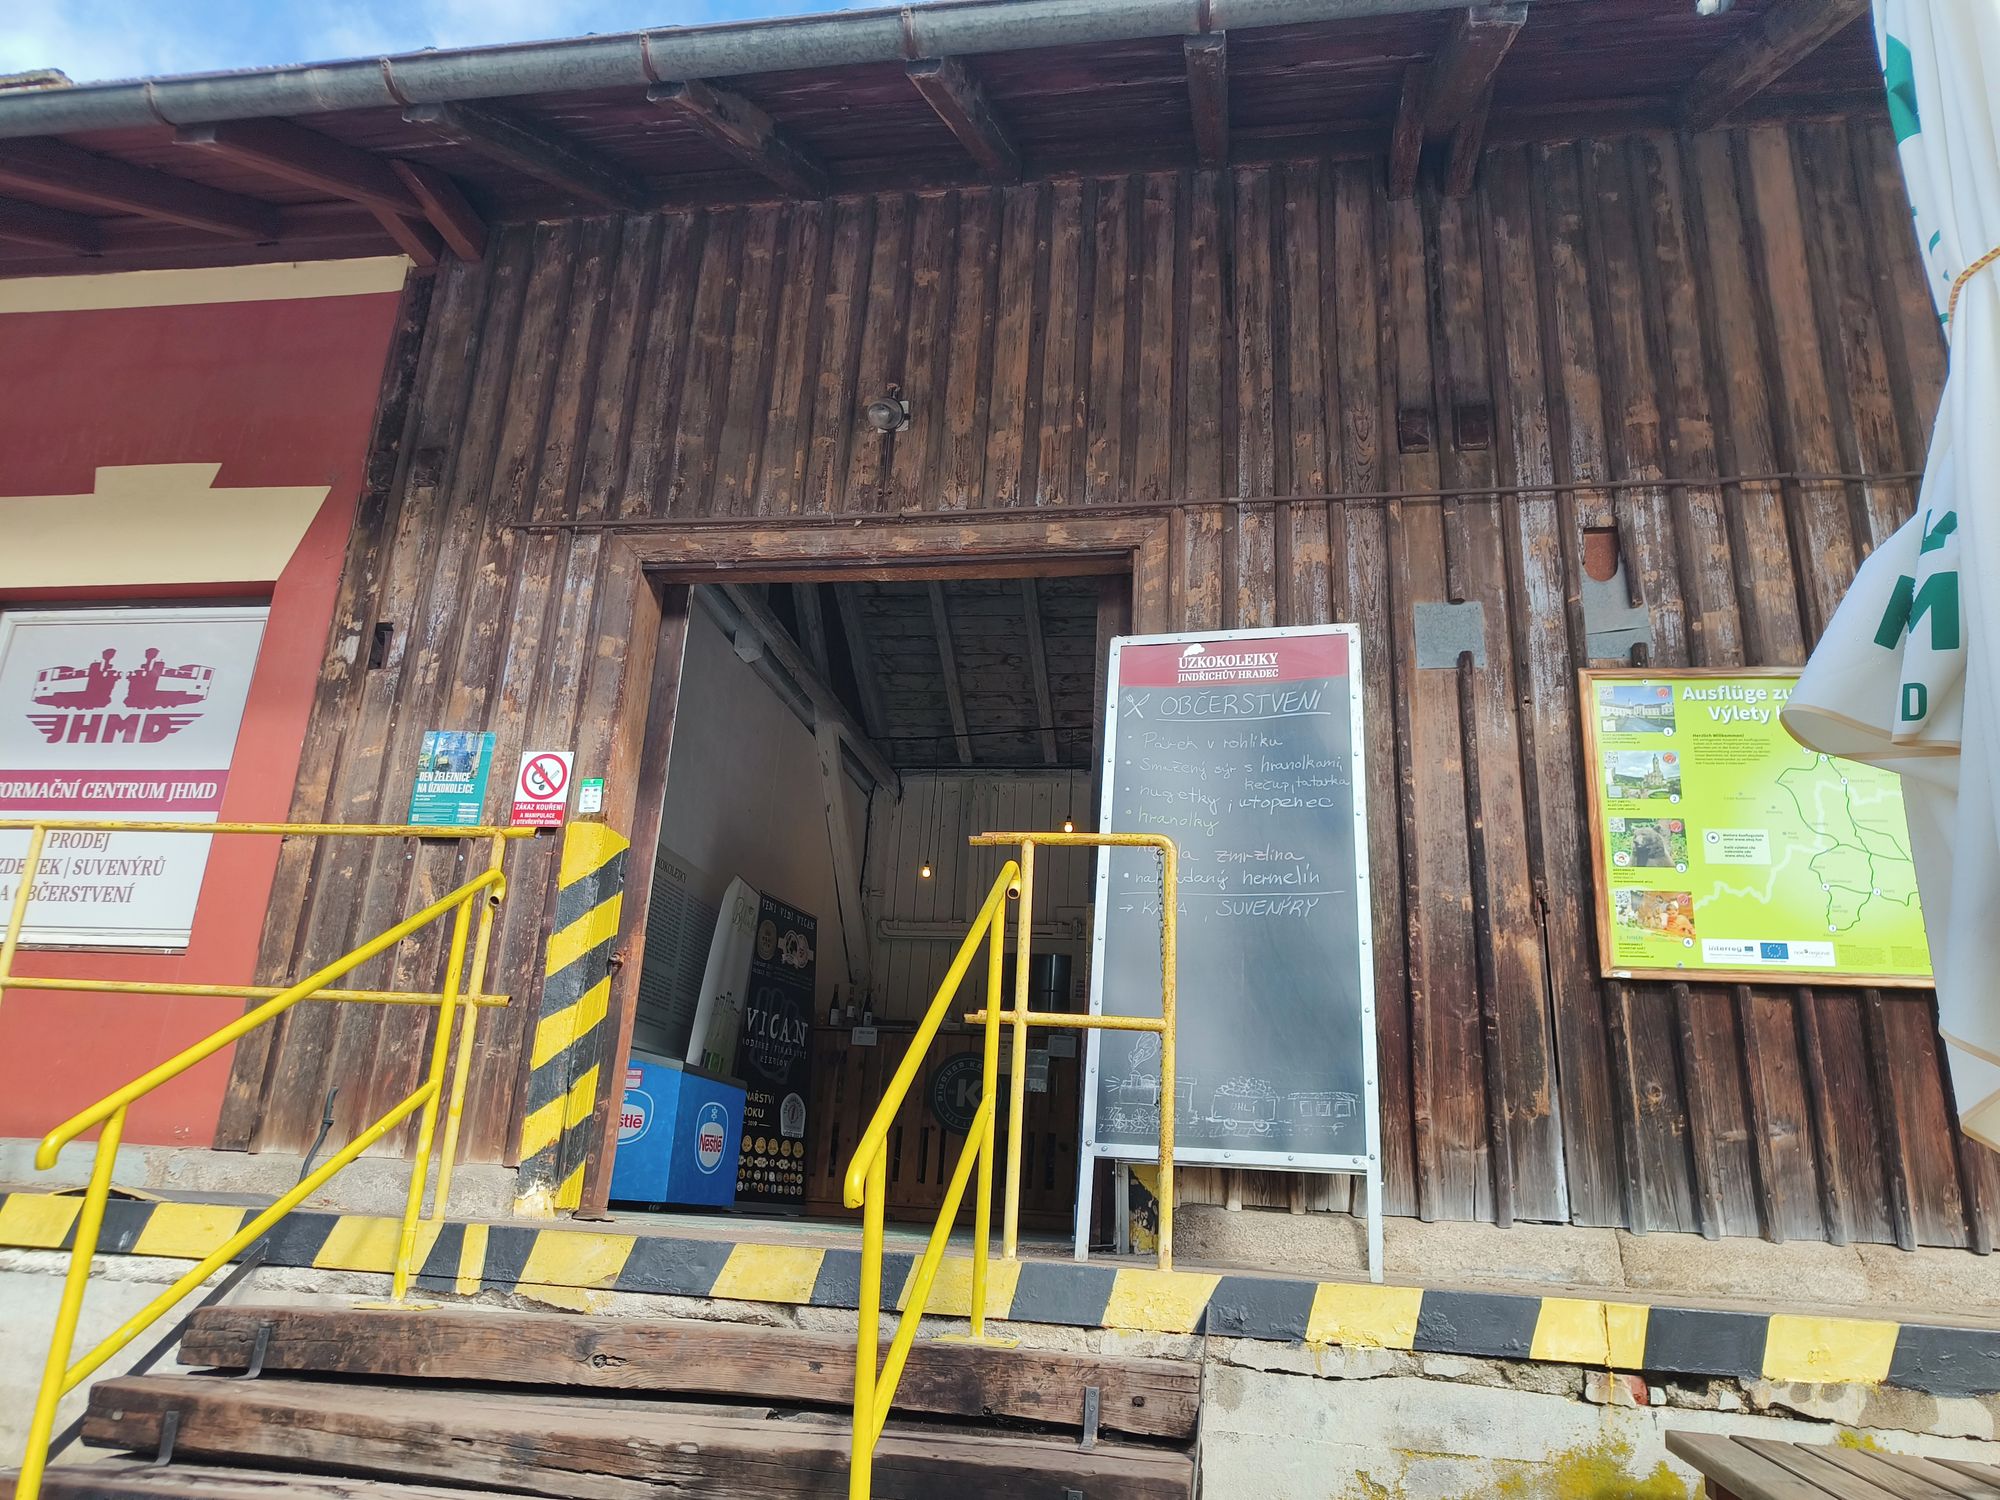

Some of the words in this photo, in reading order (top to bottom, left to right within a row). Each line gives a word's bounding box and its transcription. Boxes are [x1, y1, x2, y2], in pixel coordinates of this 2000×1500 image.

[1177, 670, 1236, 683] JINDŘICHŮV
[1238, 669, 1279, 679] HRADEC
[1160, 682, 1329, 715] OBČERSTVENÍ
[1682, 685, 1768, 704] Ausflüge
[1901, 682, 1928, 722] D
[1708, 704, 1771, 725] Výlety
[40, 713, 180, 743] JHMD
[1207, 739, 1215, 749] v
[1223, 732, 1284, 749] rohlíku
[419, 771, 434, 782] DEN
[433, 770, 472, 782] ŽELEZNICE
[1244, 763, 1253, 772] s
[82, 782, 167, 799] CENTRUM
[166, 782, 218, 803] JHMD
[416, 783, 428, 794] NA
[515, 802, 535, 811] ZÁKAZ
[536, 802, 564, 811] KOUŘENÍ
[1239, 795, 1334, 815] utopenec
[48, 832, 112, 853] PRODEJ
[72, 855, 166, 876] SUVENÝRŮ
[1242, 864, 1321, 886] hermelín
[1215, 896, 1319, 918] SUVENÝRY
[747, 1007, 809, 1048] VICAN
[699, 1134, 723, 1153] Nestlé
